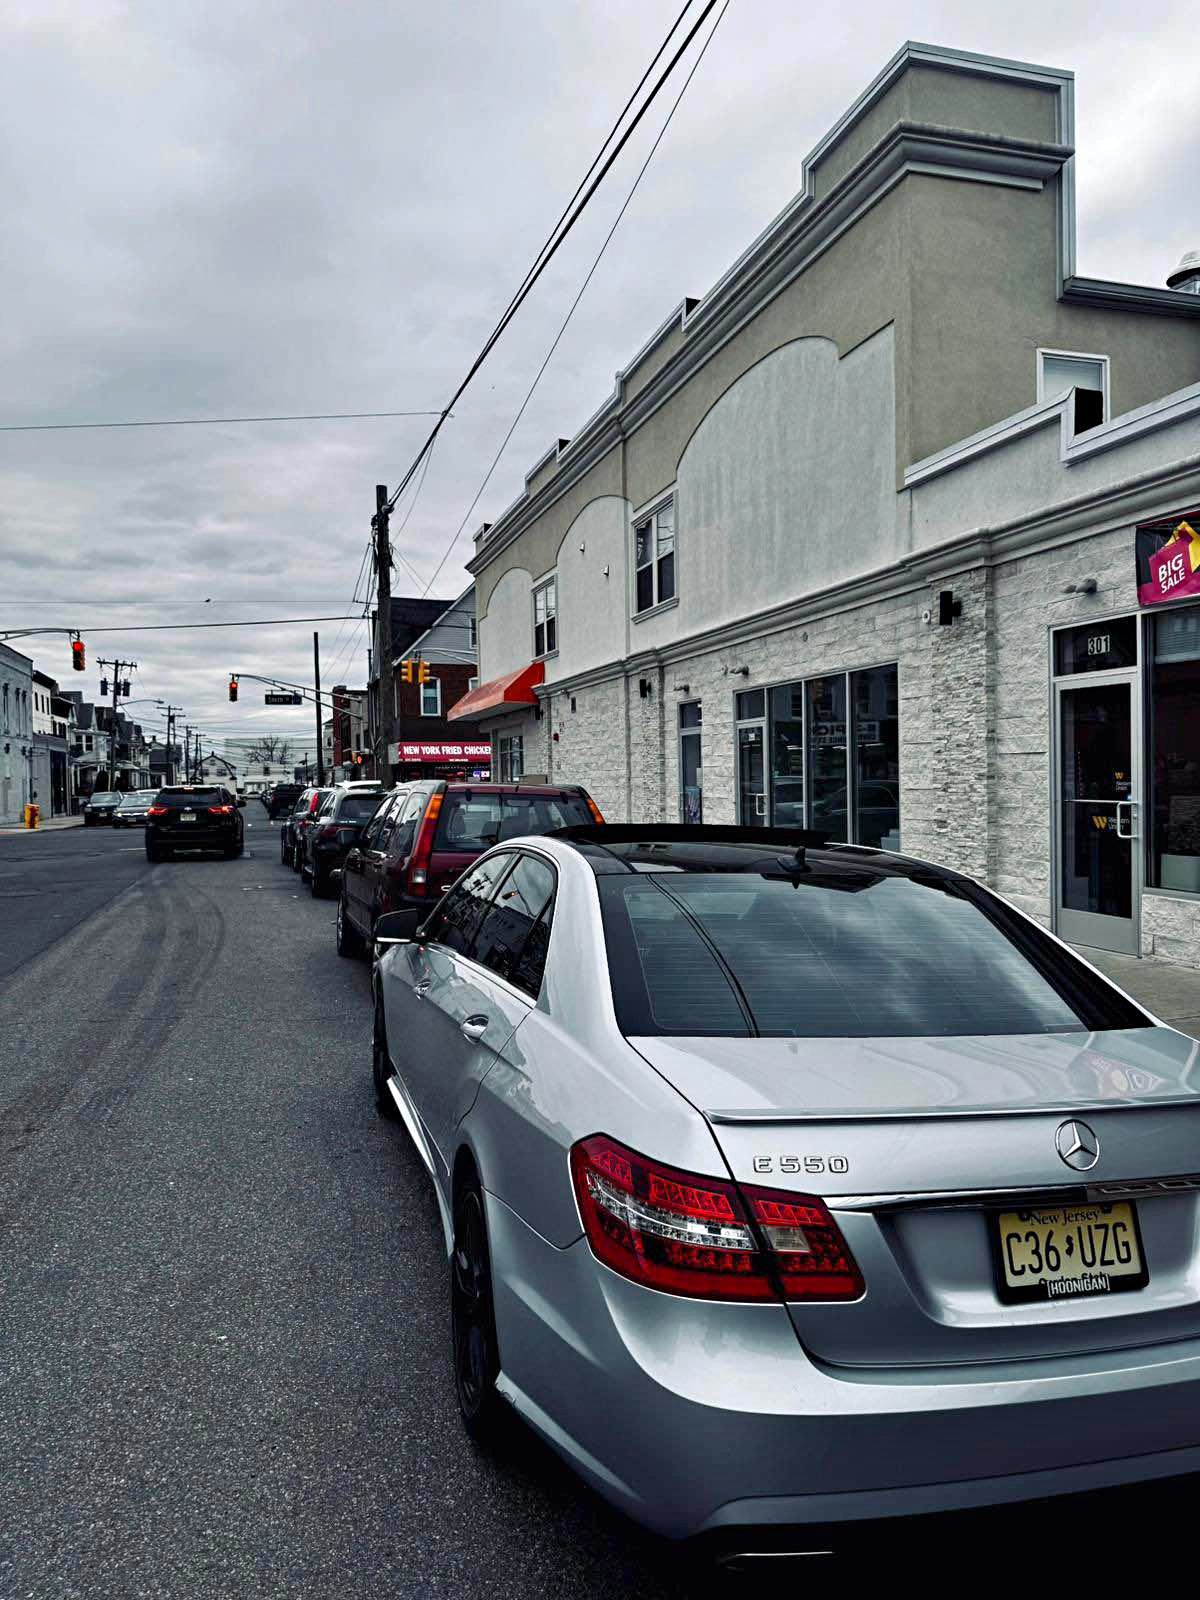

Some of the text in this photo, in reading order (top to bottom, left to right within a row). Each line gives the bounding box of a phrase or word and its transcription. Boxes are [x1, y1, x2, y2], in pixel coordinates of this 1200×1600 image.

[1158, 553, 1184, 583] BIG
[1160, 567, 1186, 594] SALE
[1088, 635, 1110, 655] 301
[403, 745, 420, 755] NEW
[421, 745, 441, 755] YORK
[442, 745, 462, 755] FRIED
[1030, 1209, 1099, 1225] New Jersey
[1006, 1221, 1132, 1276] C36 UZG
